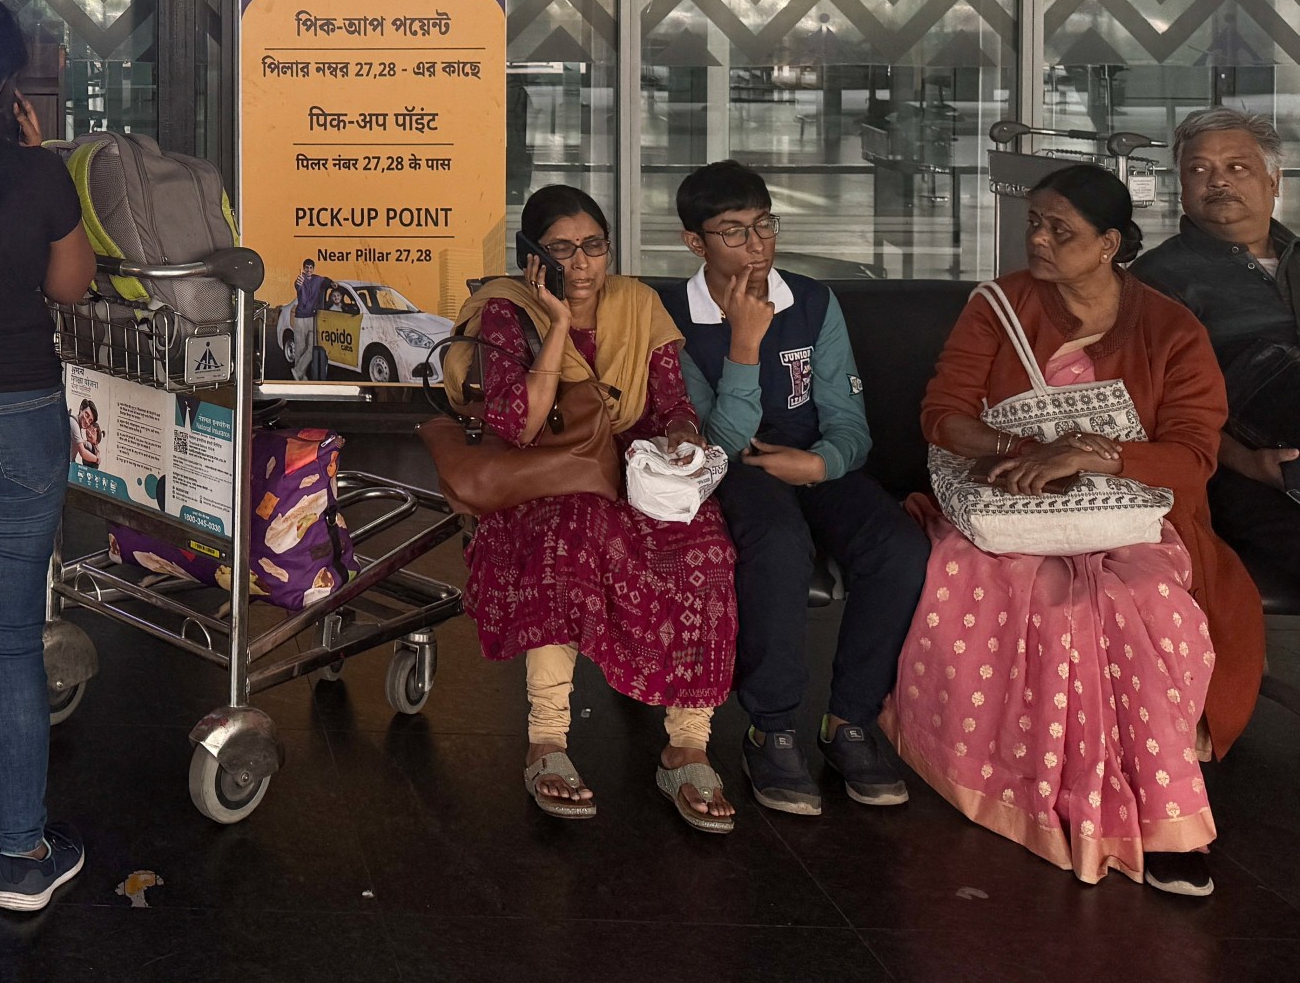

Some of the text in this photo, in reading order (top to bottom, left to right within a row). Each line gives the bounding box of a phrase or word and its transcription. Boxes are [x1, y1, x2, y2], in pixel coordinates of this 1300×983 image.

[295, 9, 385, 37] পিক-আপ
[262, 55, 311, 78] পিলার
[315, 61, 350, 79] নম্বর
[355, 62, 397, 79] 27,28
[412, 61, 437, 78] এর
[442, 60, 482, 80] কাছে
[308, 105, 438, 133] पिक-अप पॉइंट
[296, 153, 451, 173] पिलर नंबर 27,28 के पास
[295, 207, 452, 227] PICK-UP POINT
[317, 248, 432, 263] Near Pillar 27,28
[321, 328, 352, 346] rapido
